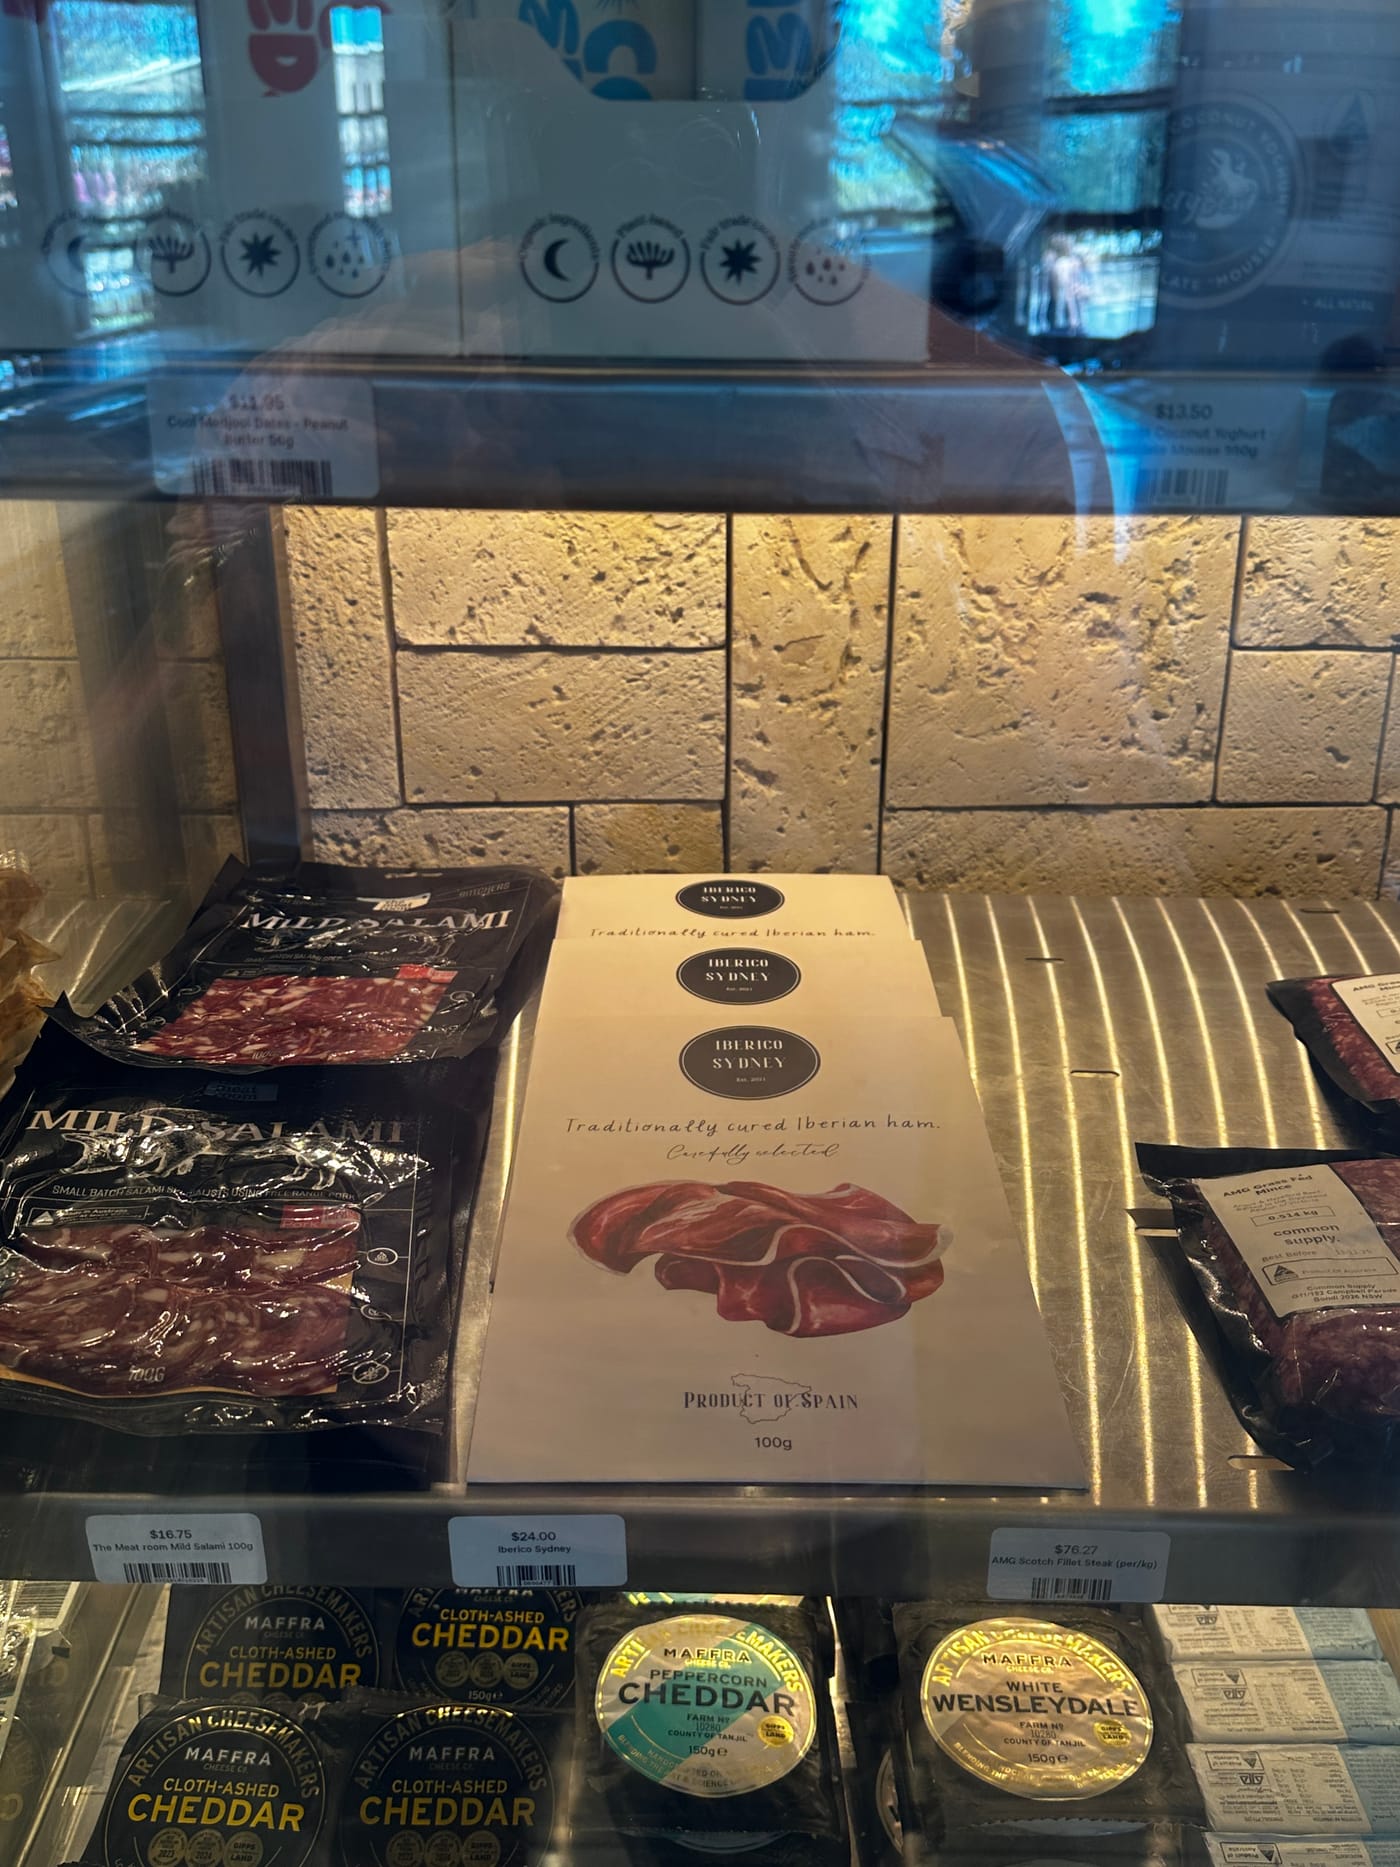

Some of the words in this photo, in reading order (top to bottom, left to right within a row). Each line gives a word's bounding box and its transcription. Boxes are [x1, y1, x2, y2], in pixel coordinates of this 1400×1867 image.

[1156, 403, 1213, 421] $13.50
[702, 886, 757, 894] IBERICO
[700, 895, 758, 904] SYDNEY
[240, 910, 348, 930] MILD
[590, 927, 706, 939] Traditionally
[713, 927, 759, 938] cured
[765, 928, 827, 938] Iberian
[833, 928, 876, 938] ham.
[708, 958, 769, 969] IBERICO
[705, 971, 771, 982] SYDNEY
[715, 1039, 784, 1051] IBERICO
[712, 1056, 787, 1070] SYDNEY
[28, 1107, 173, 1138] MILD
[203, 1118, 405, 1143] SALAMI
[565, 1117, 719, 1137] Traditionally
[727, 1117, 788, 1133] cured
[797, 1116, 876, 1132] Iberian
[887, 1114, 941, 1130] ham.
[666, 1143, 750, 1166] Carefully
[755, 1143, 840, 1159] selected
[52, 1184, 88, 1198] SMALL
[89, 1185, 125, 1198] BATCH
[124, 1185, 166, 1196] SALAMI
[230, 1186, 264, 1198] USING
[1222, 1186, 1251, 1198] AMG
[1252, 1178, 1288, 1190] Grass
[1255, 1183, 1293, 1196] Mince
[1272, 1224, 1340, 1238] common
[1284, 1234, 1341, 1246] supply.
[683, 1391, 764, 1409] PRODUCT
[773, 1393, 793, 1409] OF
[800, 1391, 859, 1410] SPAIN
[754, 1436, 793, 1451] 100g
[149, 1529, 193, 1540] $16.75
[511, 1531, 557, 1542] $24.00
[93, 1543, 112, 1552] The
[114, 1543, 140, 1552] Meat
[170, 1543, 192, 1551] Mild
[193, 1542, 226, 1551] Salami
[228, 1542, 254, 1552] 100g
[497, 1545, 533, 1554] Iberico
[534, 1545, 571, 1555] Sydney
[1054, 1544, 1099, 1556] $76.27
[991, 1556, 1017, 1566] AMG
[1018, 1556, 1054, 1566] Scotch
[1056, 1557, 1082, 1567] Fillet
[1084, 1558, 1113, 1568] Steak
[1115, 1559, 1159, 1571] (per/kg)
[195, 1585, 258, 1655] ARTISAN
[260, 1585, 373, 1659] CHEESEMAKERS
[245, 1615, 326, 1631] MAFFRA
[439, 1608, 545, 1624] CLOTH-ASHED
[411, 1622, 570, 1652] CHEDDAR
[229, 1646, 337, 1661] CLOTH-ASHED
[663, 1647, 753, 1664] MAFFRA
[931, 1629, 990, 1687] ARTISAN
[982, 1652, 1072, 1668] MAFFRA
[200, 1660, 362, 1690] CHEDDAR
[649, 1668, 768, 1689] PEPPERCORN
[1006, 1681, 1063, 1694] WHITE
[618, 1682, 796, 1718] CHEDDAR
[931, 1693, 1142, 1718] WENSLEYDALE
[686, 1713, 715, 1723] FARM
[1019, 1721, 1049, 1730] FARM
[667, 1729, 701, 1738] COUNTY
[702, 1731, 717, 1740] OF
[717, 1733, 748, 1743] TANJIL
[1003, 1737, 1039, 1746] COUNTY
[127, 1717, 202, 1787] ARTISAN
[207, 1709, 320, 1800] CHEESEMAKERS
[184, 1747, 272, 1767] MAFFRA
[354, 1713, 420, 1790] ARTISAN
[426, 1706, 548, 1793] CHEESEMAKERS
[408, 1746, 496, 1762] MAFFRA
[688, 1744, 716, 1758] 150g
[1027, 1752, 1056, 1765] 150g
[203, 1762, 237, 1773] CHEESE
[163, 1777, 280, 1798] CLOTH-ASHED
[391, 1778, 508, 1794] CLOTH-ASHED
[127, 1793, 305, 1833] CHEDDAR
[359, 1796, 536, 1827] CHEDDAR
[233, 1842, 256, 1851] GIPPS
[230, 1854, 253, 1863] LAND
